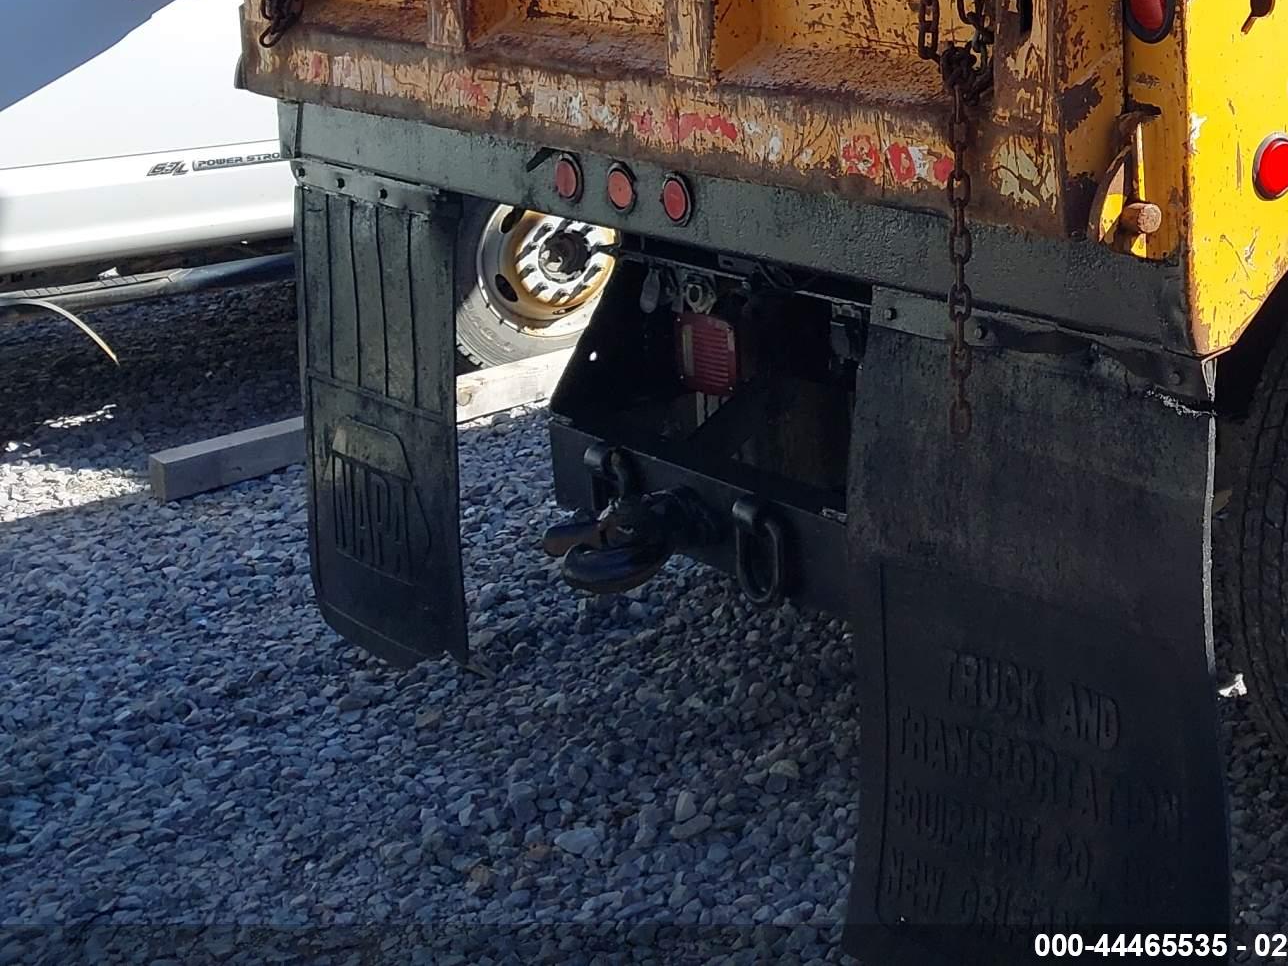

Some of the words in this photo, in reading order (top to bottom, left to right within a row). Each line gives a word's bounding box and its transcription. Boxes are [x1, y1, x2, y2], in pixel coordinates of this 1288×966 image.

[197, 156, 243, 167] POWER
[246, 152, 281, 162] STRO
[946, 648, 1046, 725] TRUCK
[1059, 681, 1123, 751] AND
